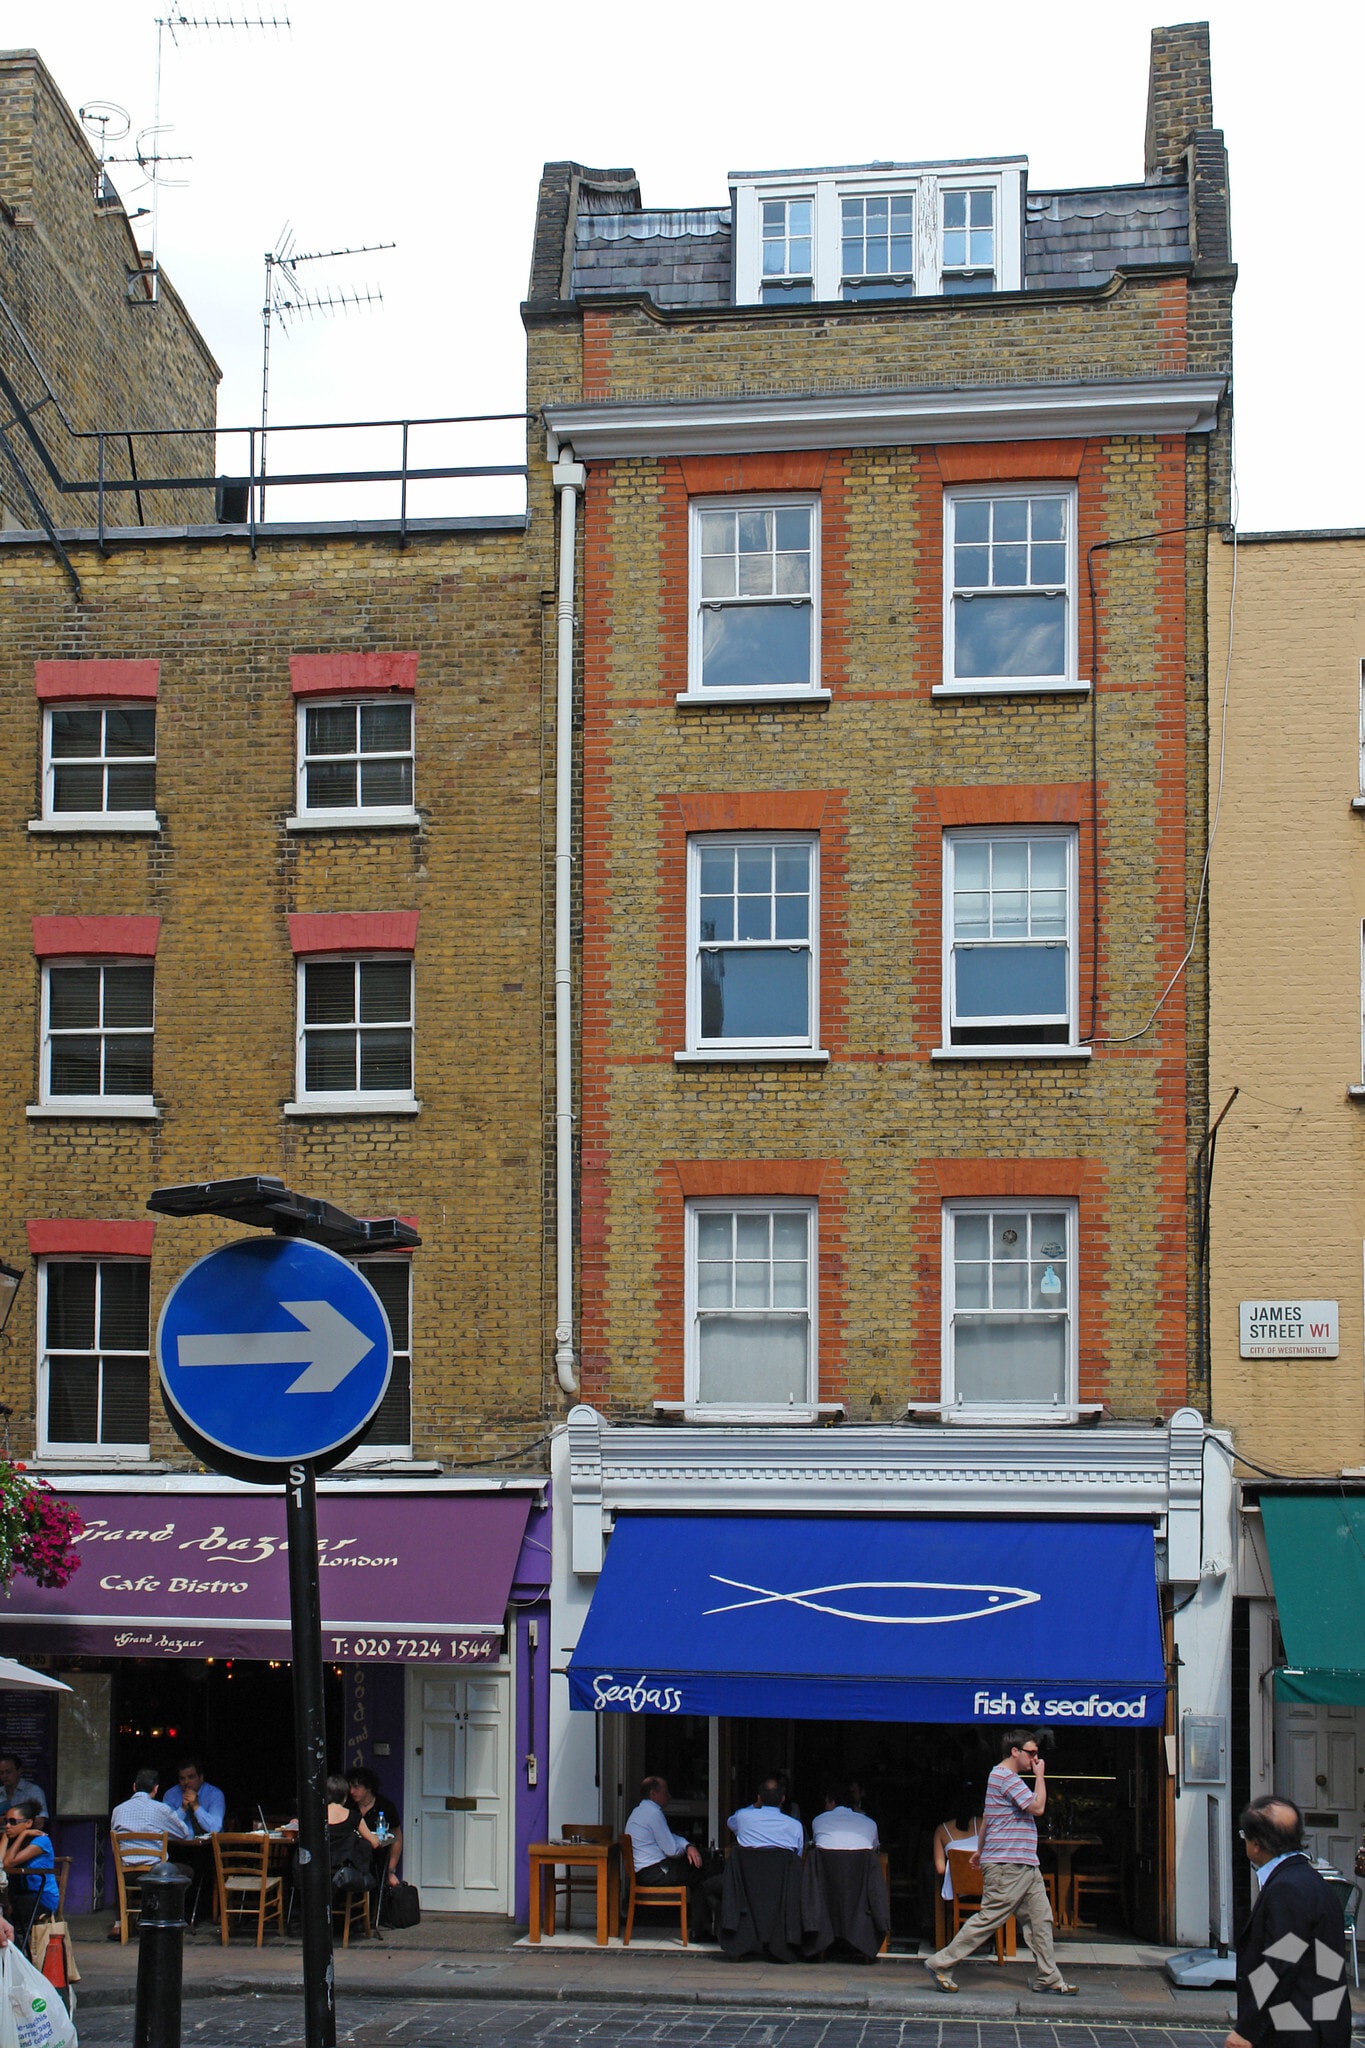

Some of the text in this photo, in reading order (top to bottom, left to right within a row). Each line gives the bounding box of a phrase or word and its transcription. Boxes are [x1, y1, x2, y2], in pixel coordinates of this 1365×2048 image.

[1250, 1307, 1301, 1321] JAMES
[1249, 1324, 1330, 1338] STREET W1
[1250, 1346, 1327, 1354] CITY OF WESTMINSTER
[318, 1554, 399, 1567] London
[99, 1575, 249, 1593] Cafe Bistro
[114, 1632, 204, 1653] Grand bazaar
[331, 1637, 492, 1659] T: 020 7224 1544
[353, 1663, 366, 1722] ood
[592, 1674, 682, 1713] Seabass
[973, 1691, 1147, 1719] fish & seafood
